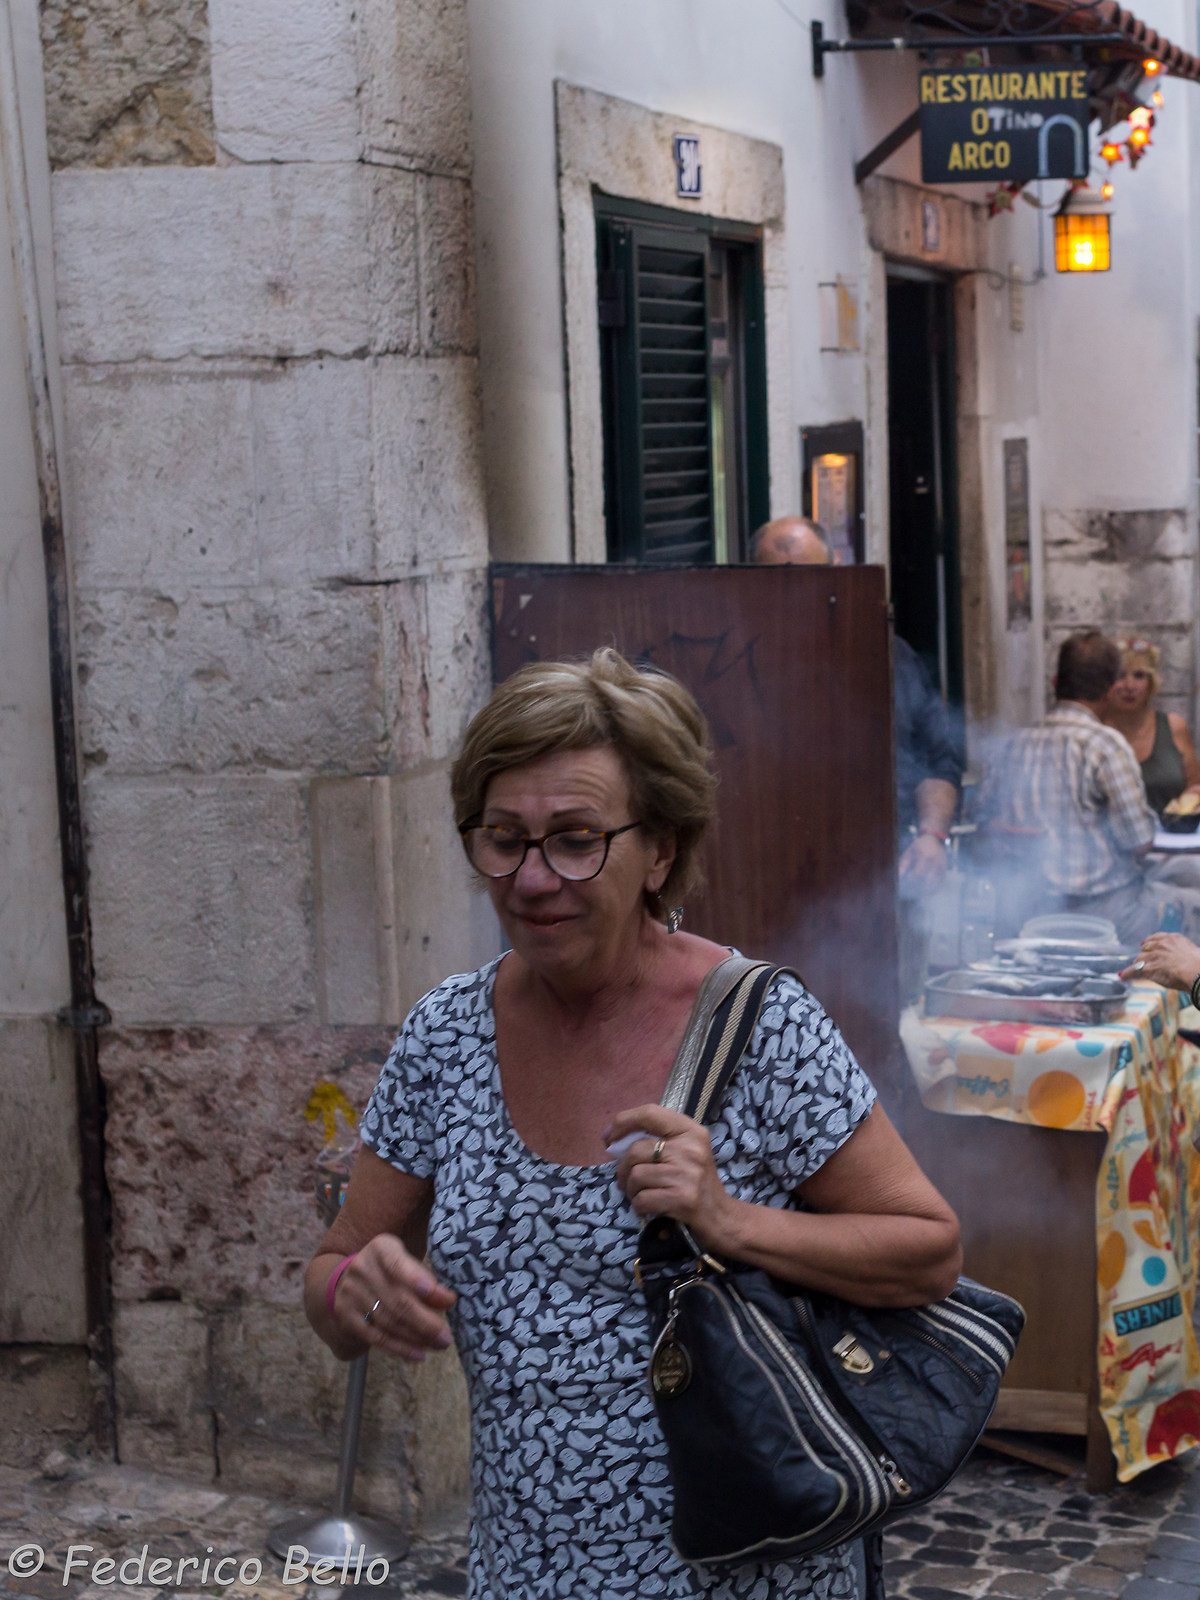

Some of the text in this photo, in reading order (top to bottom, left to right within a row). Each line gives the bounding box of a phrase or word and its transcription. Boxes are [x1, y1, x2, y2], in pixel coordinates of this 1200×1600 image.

[920, 70, 1088, 104] RESTAURANTE
[971, 107, 990, 136] O
[947, 140, 1011, 171] ARCO
[1115, 1294, 1182, 1334] DINERS
